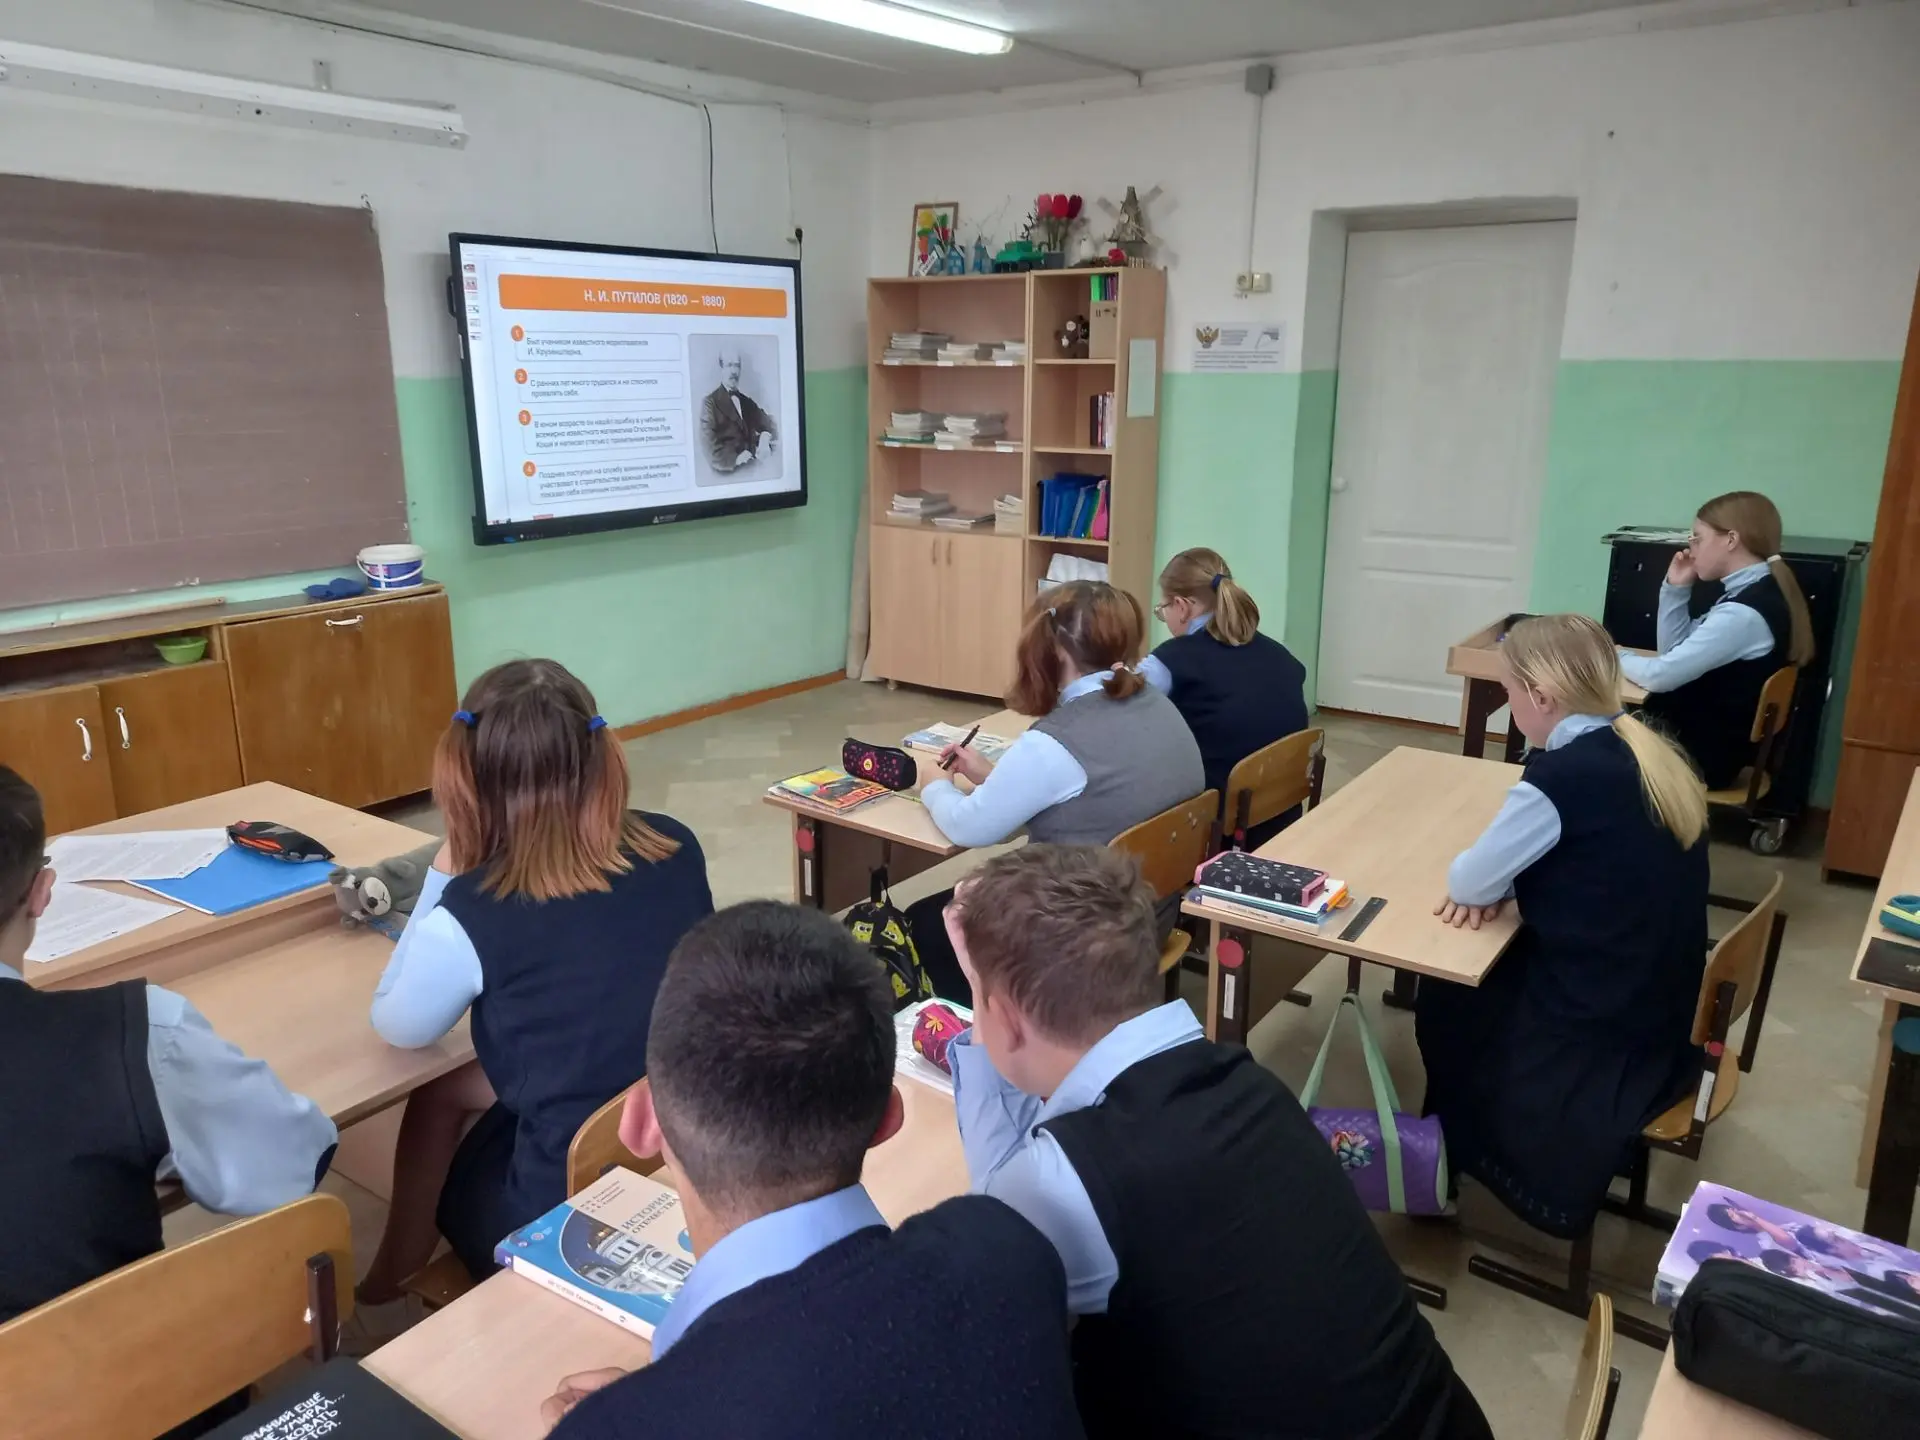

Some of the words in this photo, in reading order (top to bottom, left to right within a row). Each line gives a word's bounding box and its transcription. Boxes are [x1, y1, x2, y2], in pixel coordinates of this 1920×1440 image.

[584, 290, 595, 301] Н.
[599, 291, 609, 302] И.
[612, 291, 661, 304] ПУТИЛОВ
[663, 294, 687, 307] (1820
[702, 296, 726, 309] 1880)
[537, 380, 559, 388] ранних
[621, 1193, 673, 1230] ИСТОРИЯ
